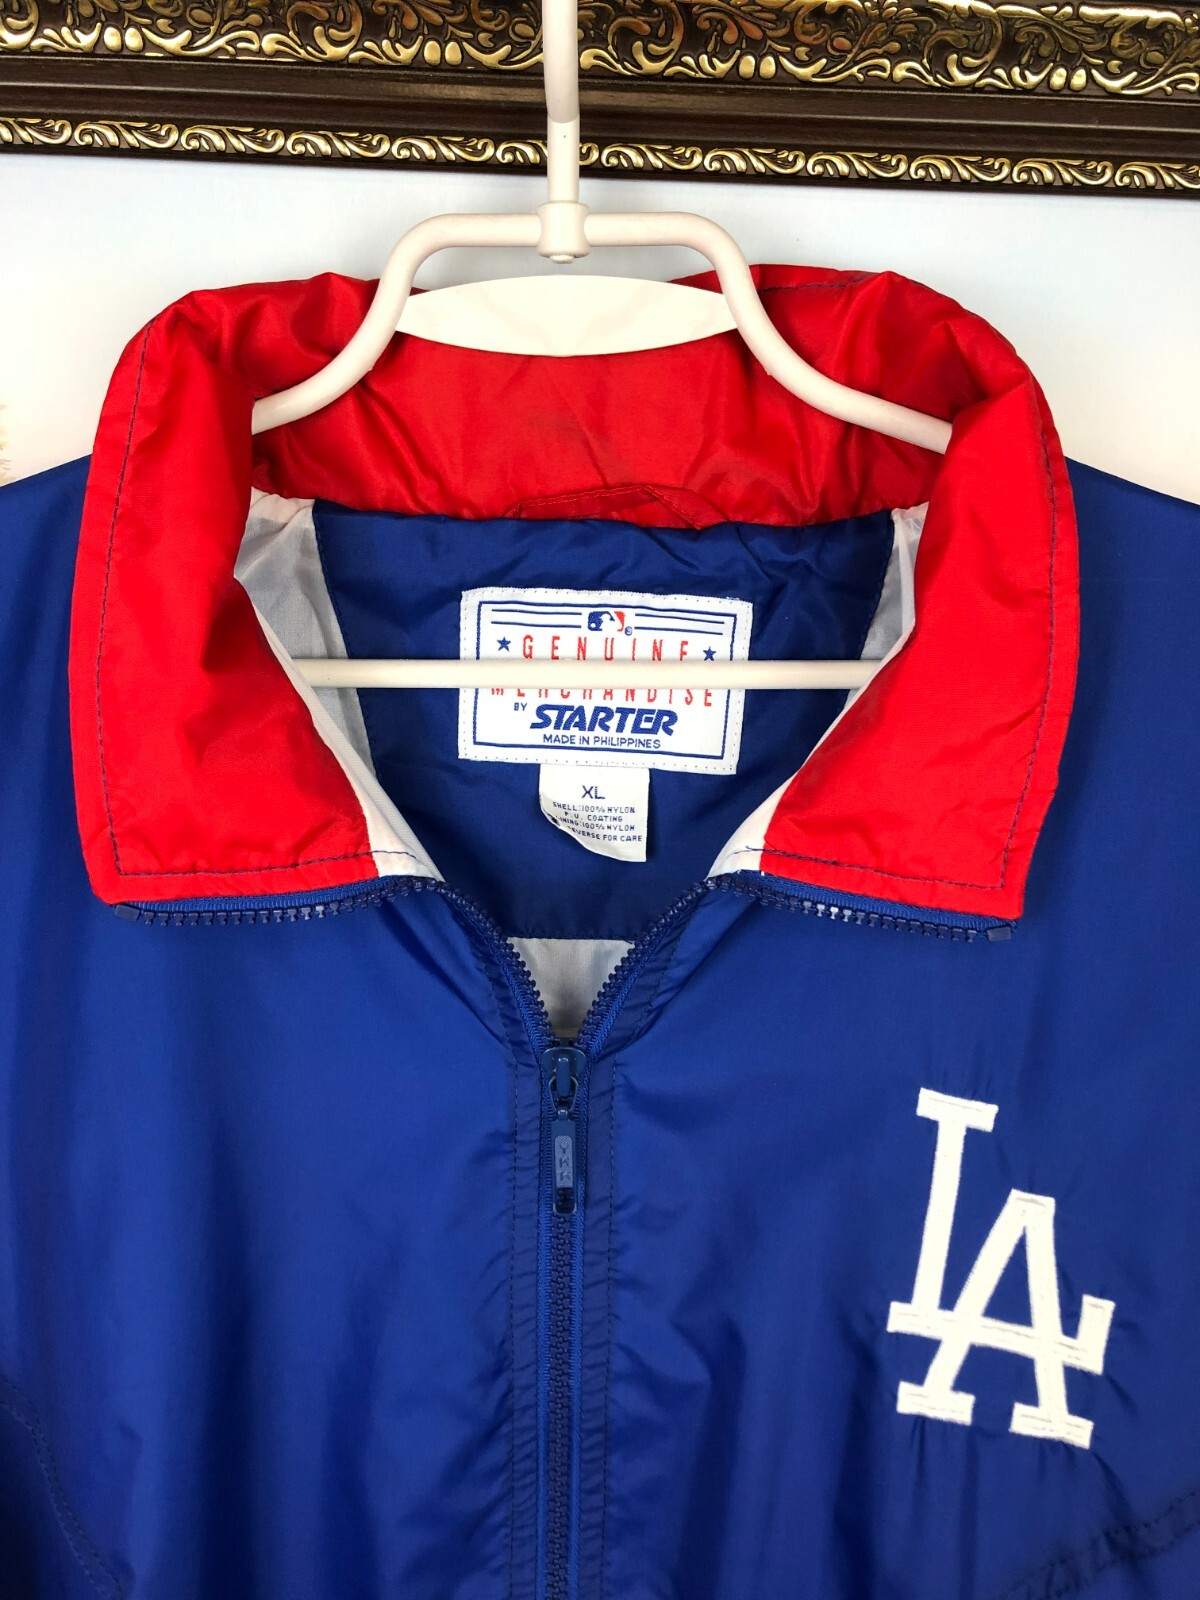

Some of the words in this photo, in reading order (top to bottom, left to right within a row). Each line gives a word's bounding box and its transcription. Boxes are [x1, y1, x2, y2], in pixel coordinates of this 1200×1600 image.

[513, 701, 528, 711] BY
[529, 703, 678, 736] STARTER
[543, 734, 576, 745] MADE
[579, 735, 590, 746] IN
[593, 736, 661, 749] PHILIPPINES
[581, 785, 605, 800] XL
[607, 806, 635, 814] NYLON
[556, 816, 605, 830] INING:100%
[607, 824, 635, 832] NYLON
[587, 814, 623, 822] COATING
[603, 834, 618, 842] FOR
[886, 1087, 1115, 1450] LA
